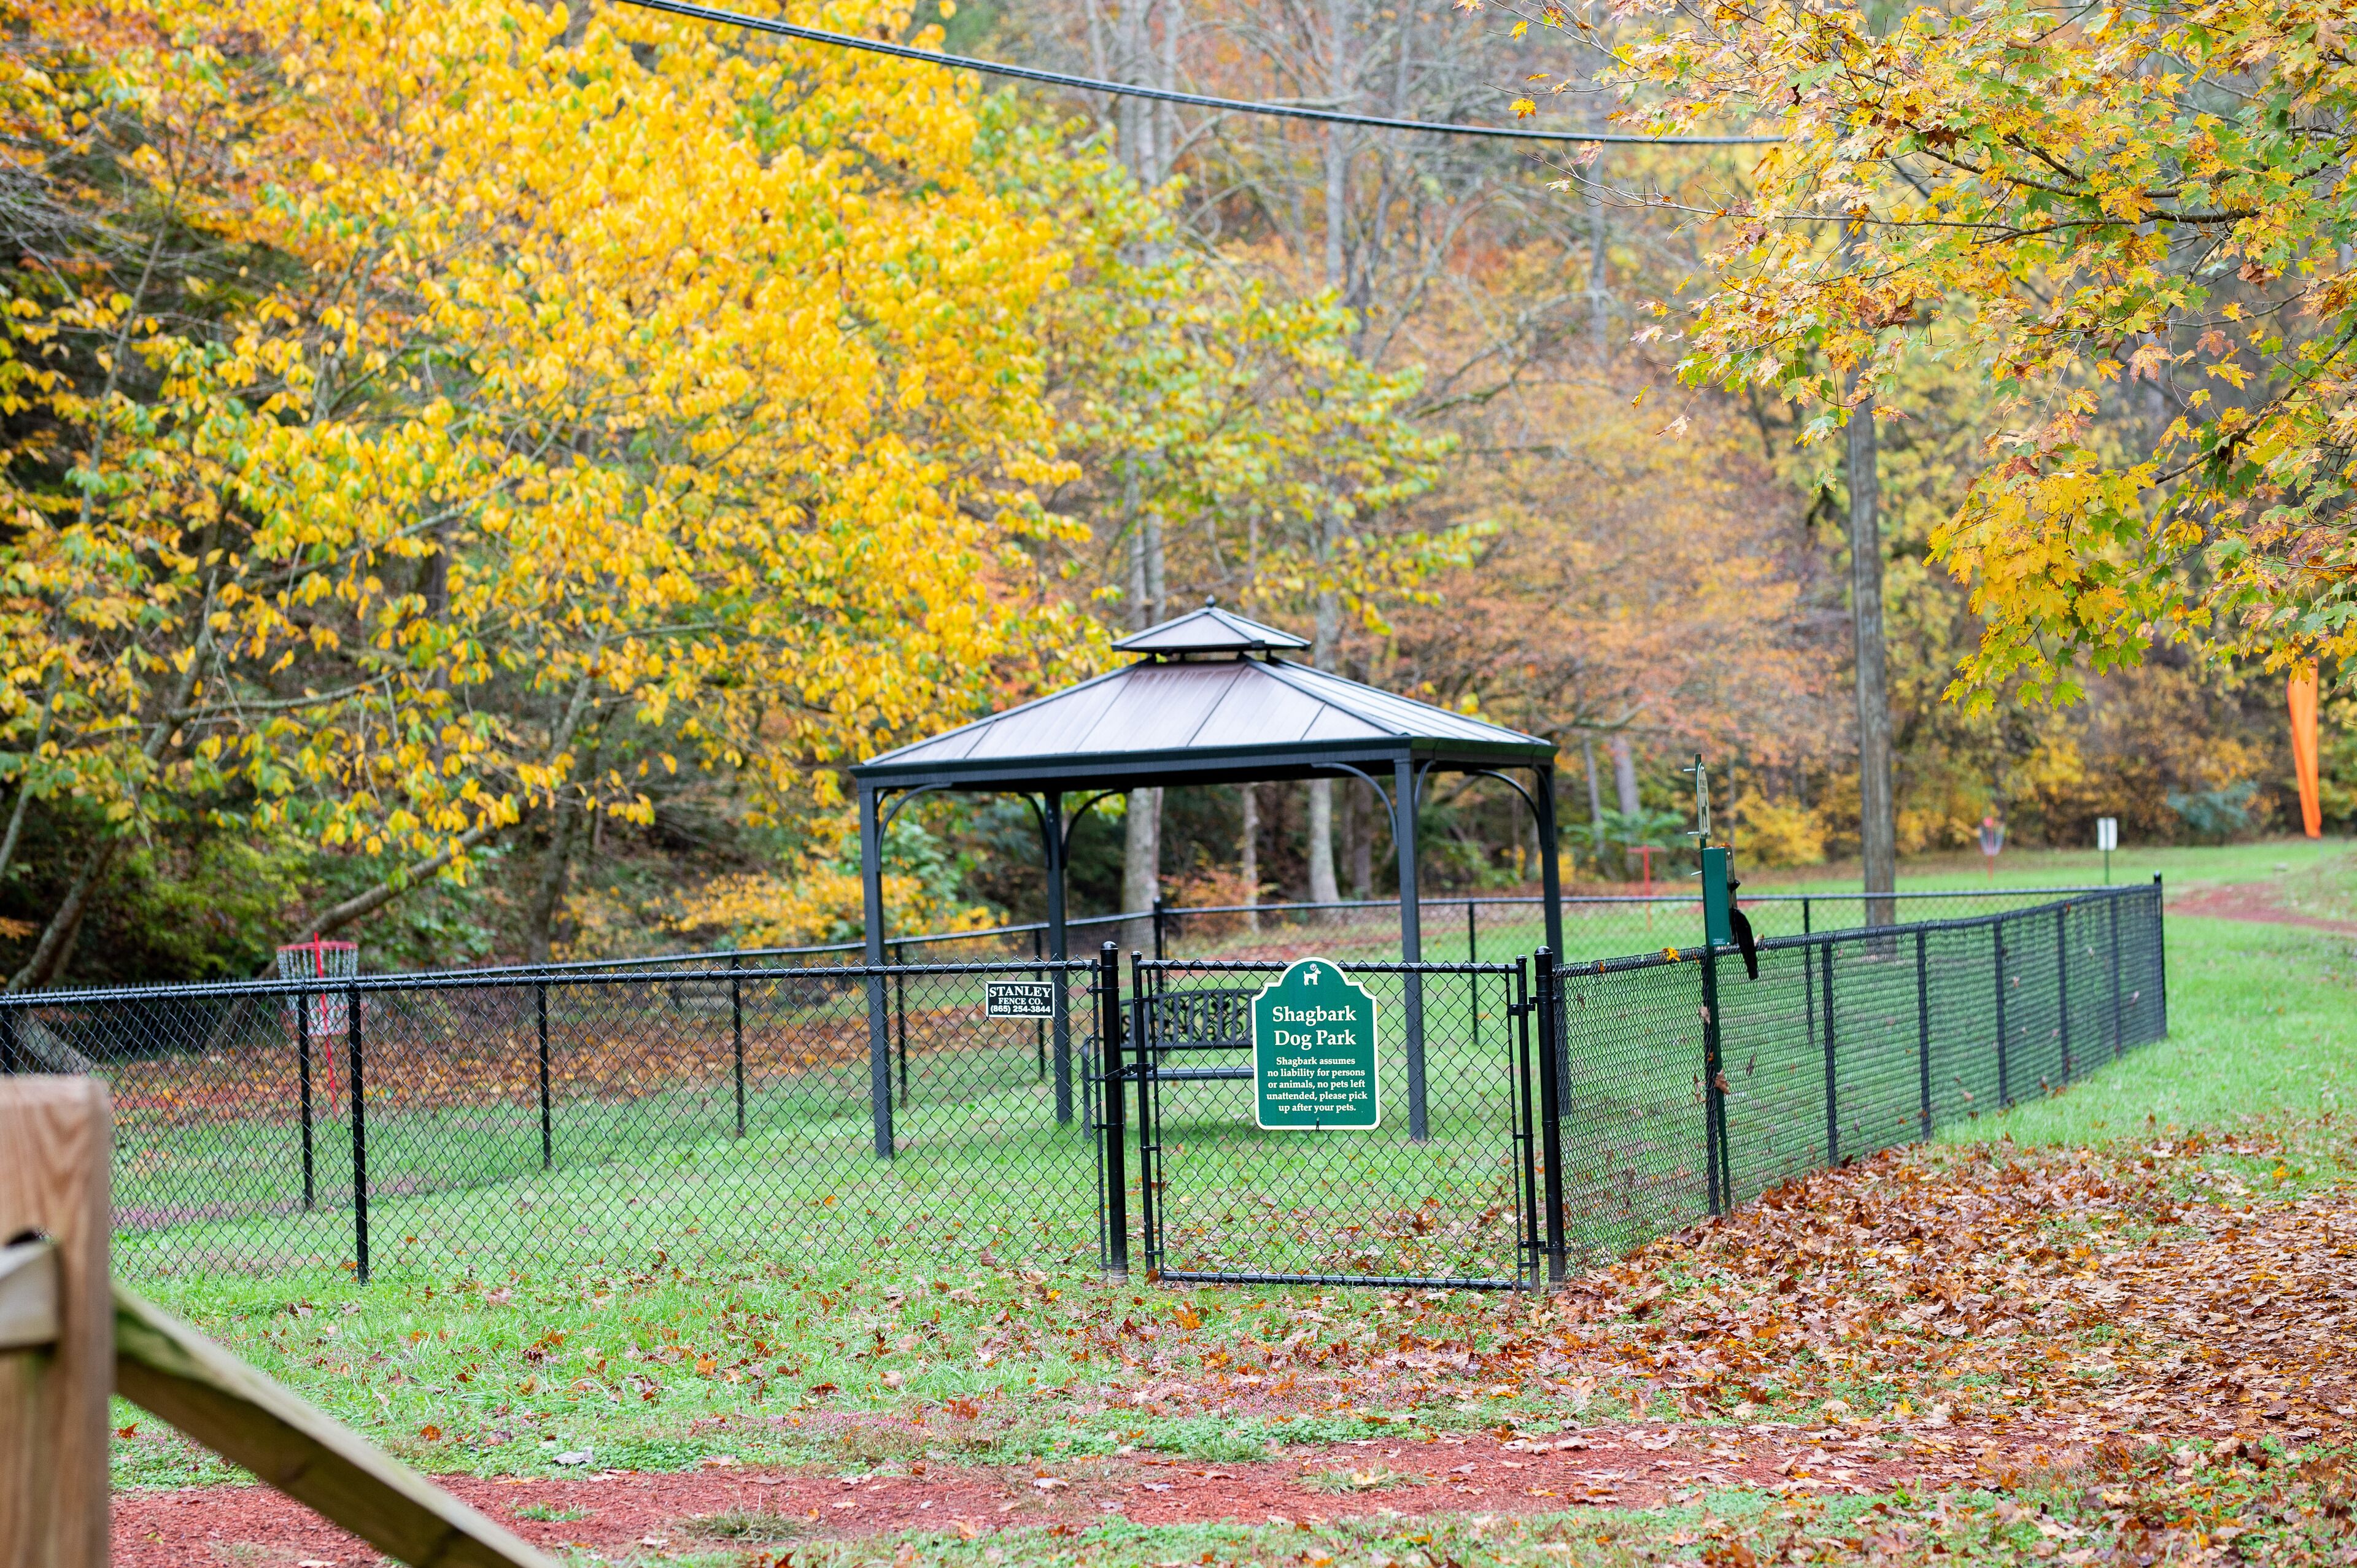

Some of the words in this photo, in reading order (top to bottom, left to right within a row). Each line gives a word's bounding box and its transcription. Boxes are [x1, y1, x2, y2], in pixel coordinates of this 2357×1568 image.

[989, 986, 1051, 997] STANLEY
[1272, 1005, 1357, 1027] Shagbark
[1274, 1030, 1312, 1051] Dog
[1316, 1029, 1357, 1046] Park
[1276, 1057, 1317, 1067] Shagbark
[1280, 1068, 1315, 1078] liability
[1279, 1080, 1315, 1089] animals,
[1330, 1081, 1348, 1090] pets
[1266, 1092, 1318, 1102] unattended,
[1319, 1092, 1347, 1102] please
[1349, 1091, 1368, 1101] pick
[1279, 1105, 1290, 1113] up
[1335, 1103, 1357, 1113] pets.
